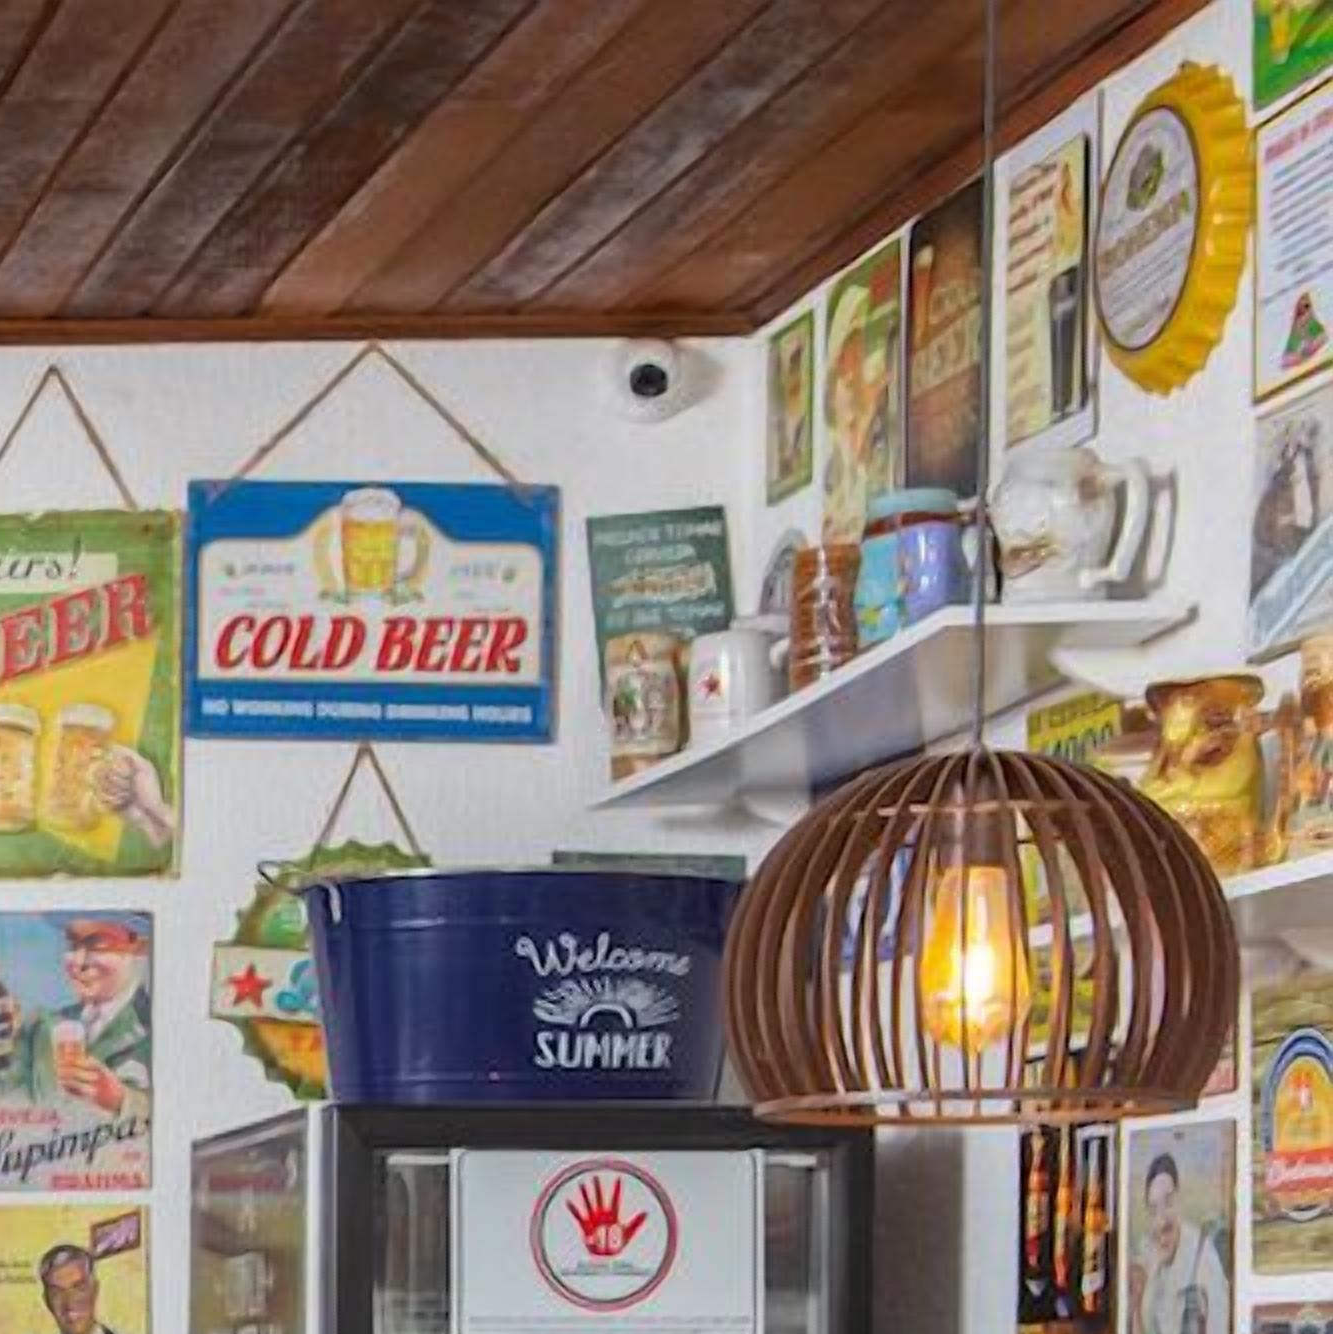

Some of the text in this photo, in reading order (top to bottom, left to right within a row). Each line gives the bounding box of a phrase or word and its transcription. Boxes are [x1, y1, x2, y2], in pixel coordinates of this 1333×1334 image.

[213, 614, 530, 674] COLD BEER
[515, 931, 692, 977] Welcome
[533, 1030, 674, 1070] SUMMER
